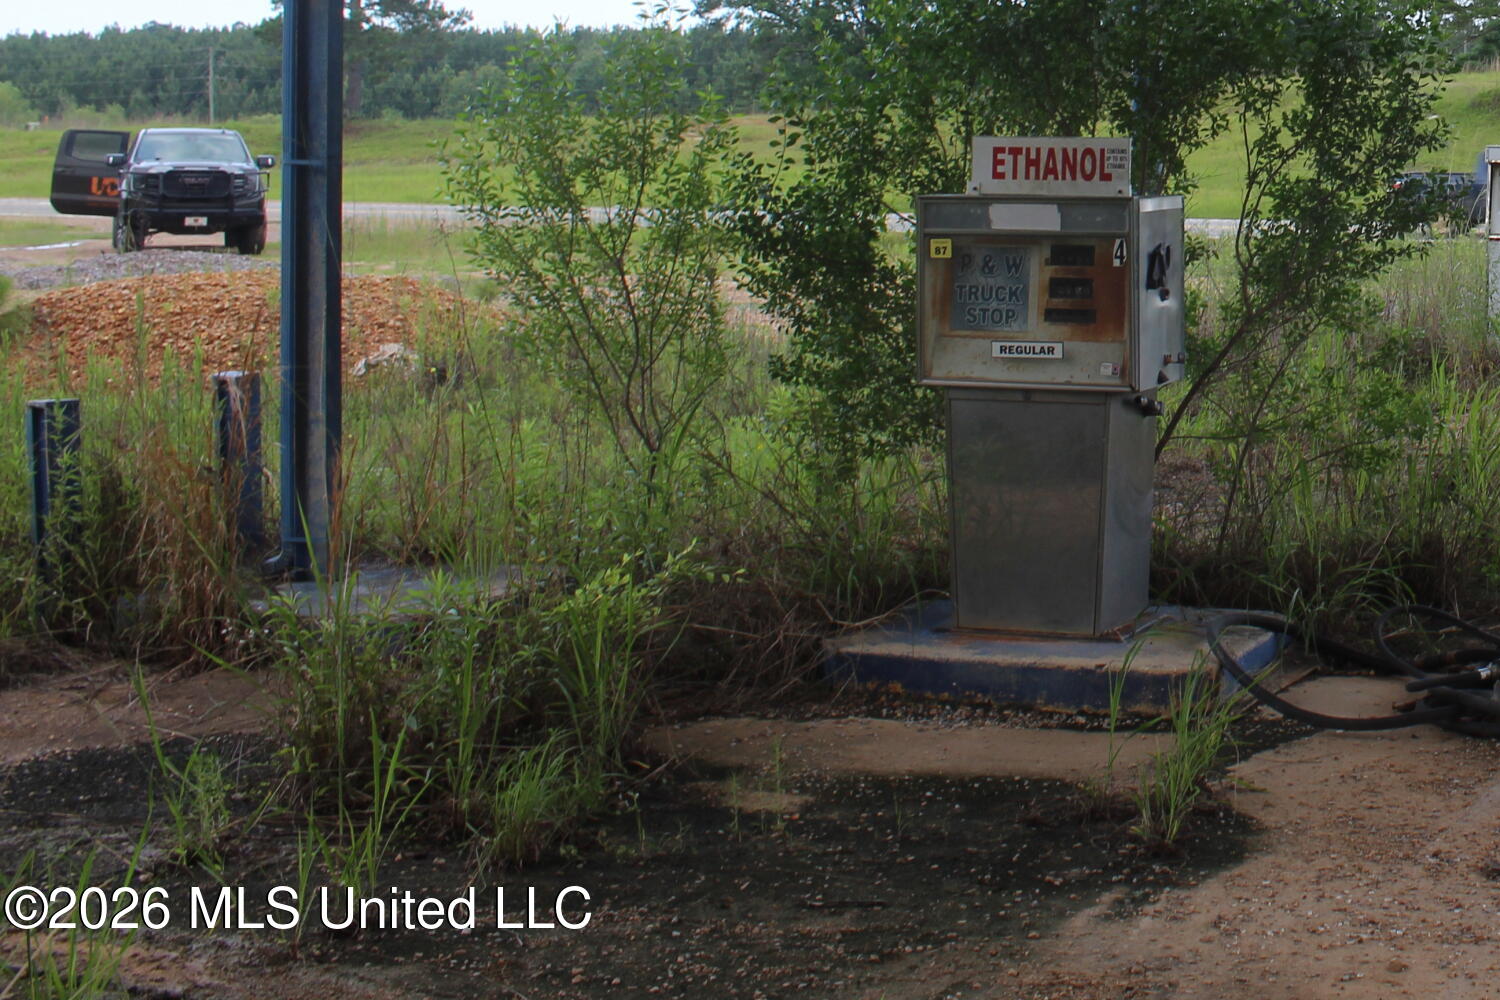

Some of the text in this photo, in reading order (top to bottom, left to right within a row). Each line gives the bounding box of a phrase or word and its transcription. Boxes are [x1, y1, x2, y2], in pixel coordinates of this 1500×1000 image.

[991, 146, 1113, 182] ETHANOL
[934, 246, 948, 255] 87
[1113, 239, 1126, 265] 4
[981, 254, 998, 277] &
[1005, 255, 1025, 278] W
[955, 284, 1024, 305] TRUCK
[967, 307, 1017, 327] STOP
[999, 344, 1056, 356] REGULAR
